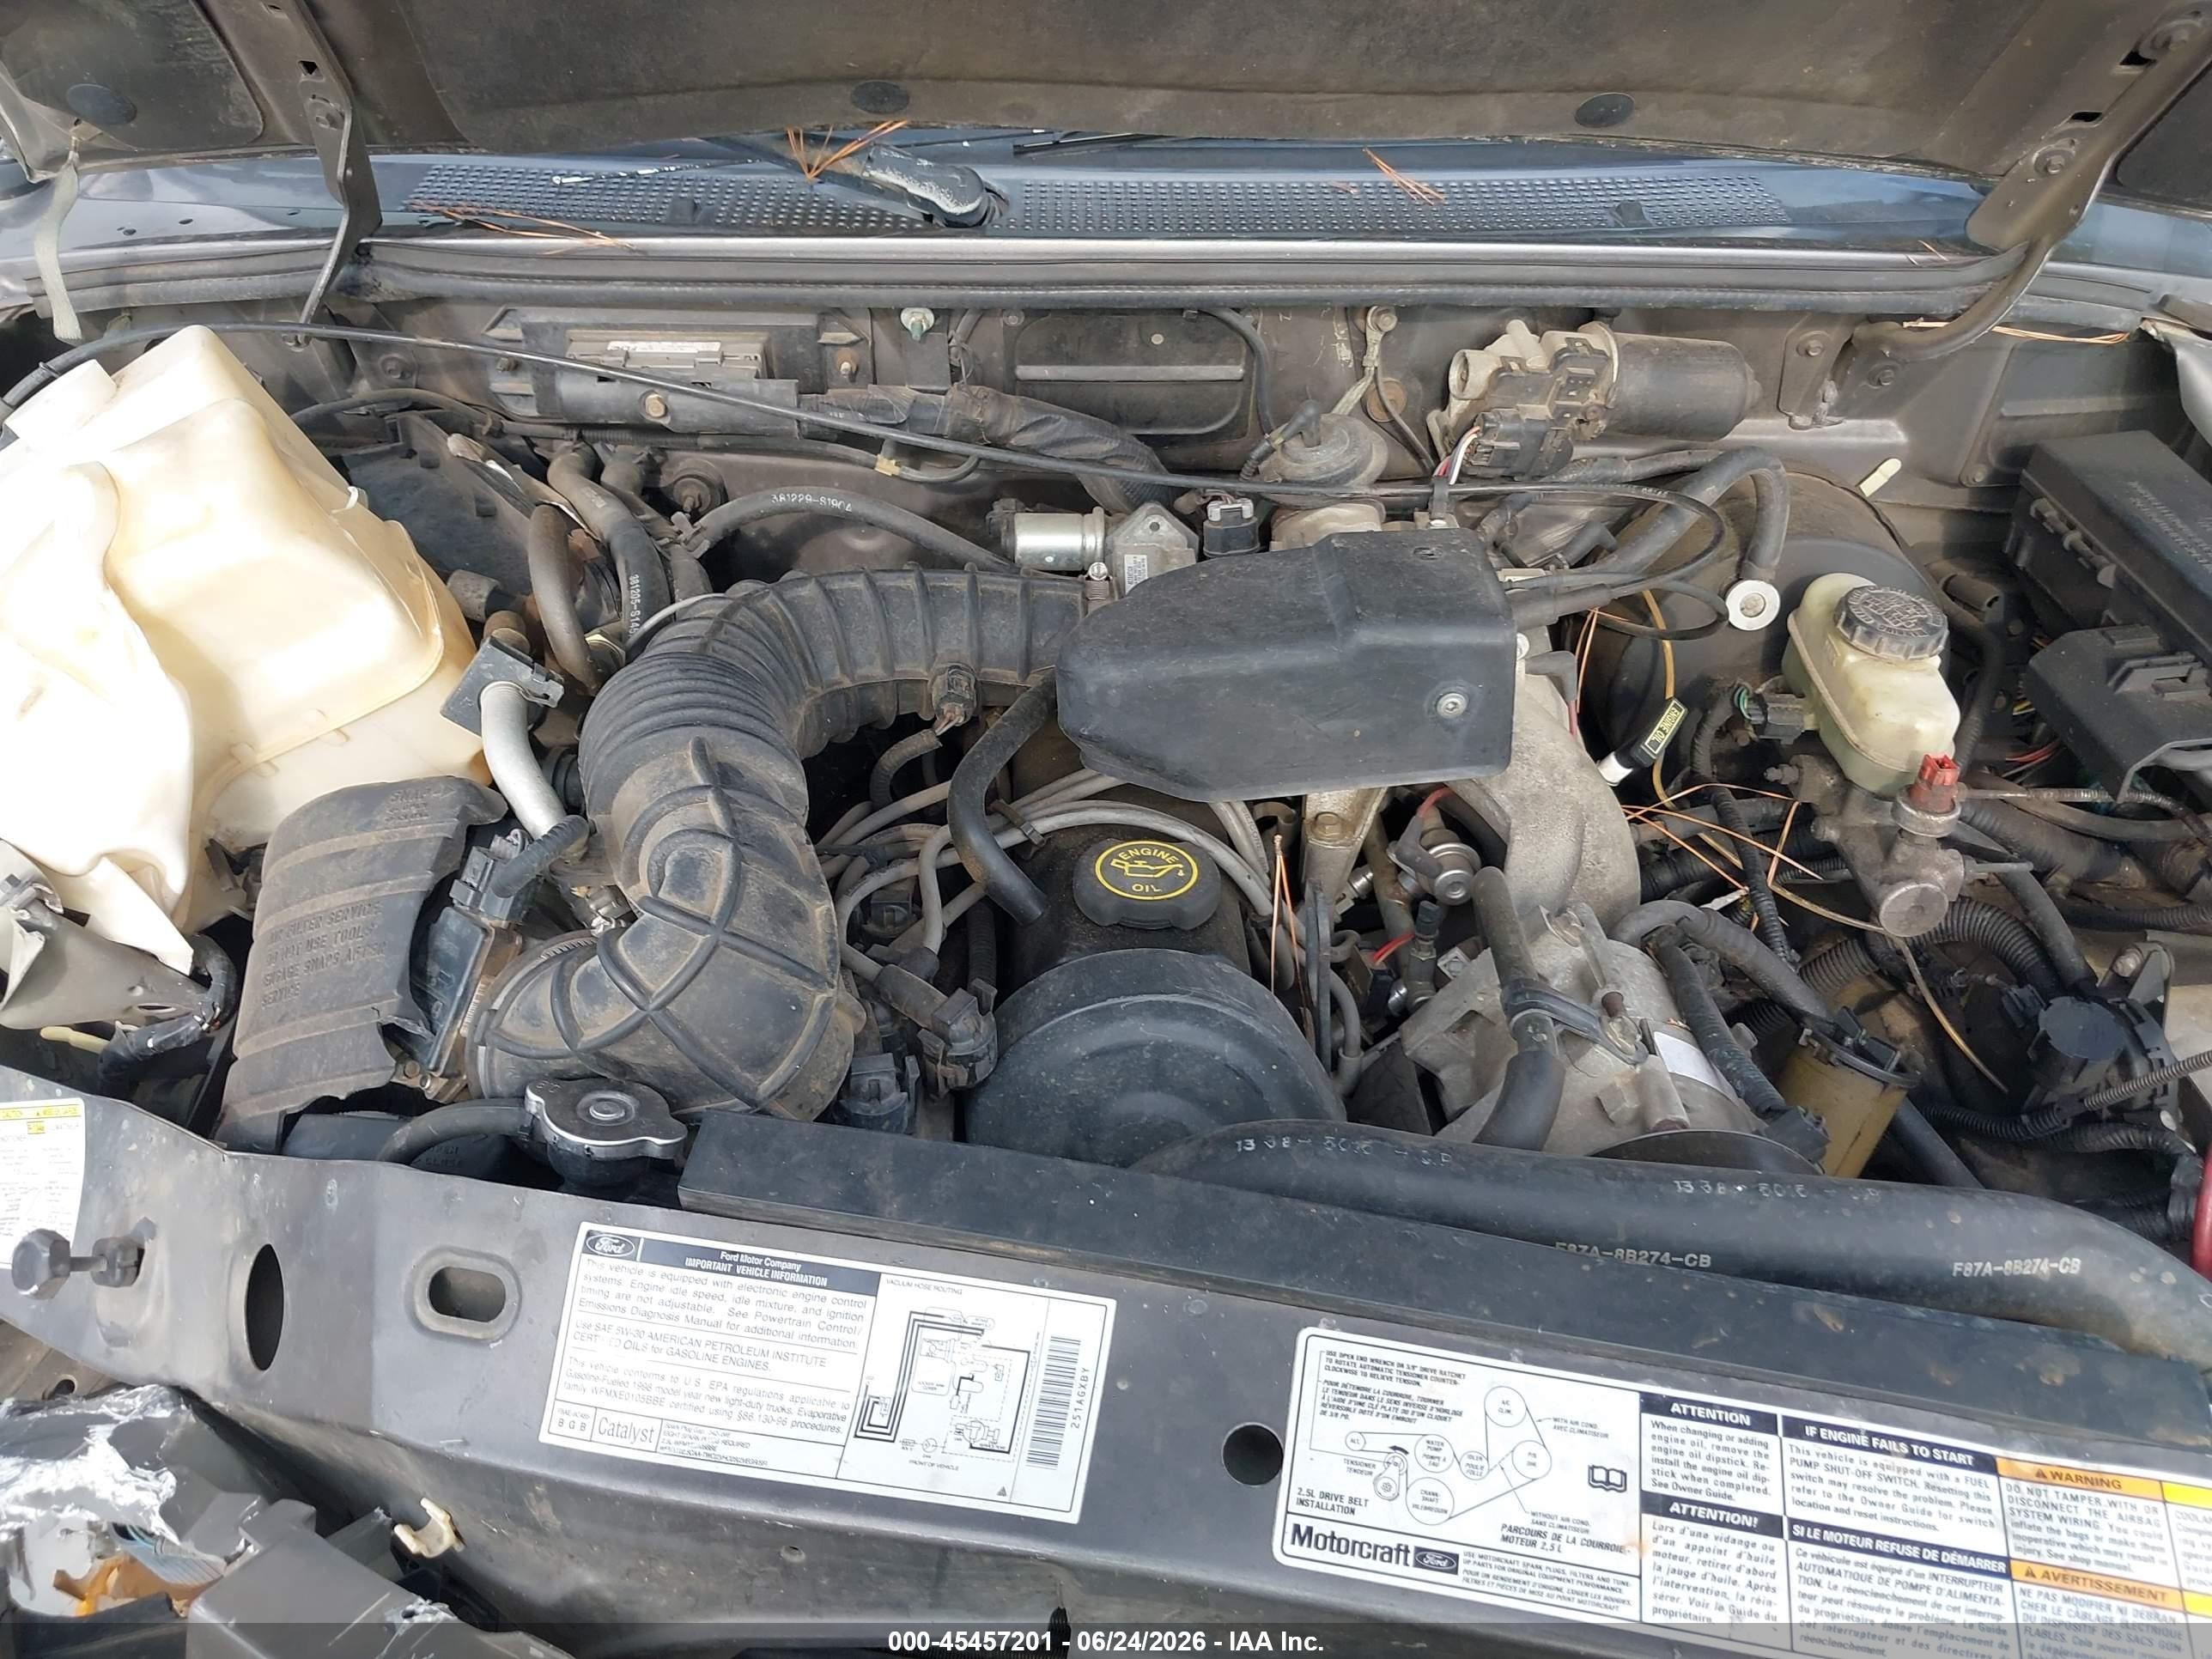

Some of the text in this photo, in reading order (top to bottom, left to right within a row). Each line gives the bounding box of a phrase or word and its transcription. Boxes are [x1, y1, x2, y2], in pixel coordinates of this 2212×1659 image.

[1650, 707, 1679, 743] ENGINE OIL
[1120, 847, 1180, 864] ENGINE
[1131, 884, 1163, 893] OIL
[593, 1235, 626, 1255] Ford
[684, 1257, 827, 1286] IMPORTANT VEHICLE INFORMATION
[720, 1251, 801, 1272] Ford Motor Company
[1952, 1256, 2082, 1277] F87A-8B274-CB
[586, 1259, 866, 1309] This vehicle is equipped with electronic engine control
[580, 1285, 861, 1336] timing are not adjustable. See Powertrain Control/
[629, 1279, 665, 1294] Engine
[670, 1285, 688, 1295] idle
[732, 1295, 750, 1304] idle
[801, 1305, 822, 1316] and
[826, 1309, 864, 1324] ignition
[578, 1298, 626, 1313] Emissions
[630, 1306, 680, 1323] Diagnosis
[684, 1315, 721, 1328] Manual
[726, 1322, 739, 1331] for
[744, 1324, 793, 1339] additional
[623, 1340, 647, 1352] OILS
[651, 1344, 663, 1354] for
[665, 1346, 719, 1363] GASOLINE
[647, 1331, 701, 1348] AMERICAN
[704, 1340, 769, 1358] PETROLEUM
[772, 1350, 826, 1367] INSTITUTE
[1070, 1367, 1090, 1428] 251AGXBY
[1670, 1402, 1750, 1425] ATTENTION
[597, 1417, 655, 1446] Catalyst
[1651, 1419, 1677, 1431] When
[1680, 1425, 1722, 1441] changing
[1738, 1437, 1768, 1449] adding
[1651, 1433, 1685, 1447] engine
[1711, 1443, 1748, 1455] remove
[1753, 1450, 1769, 1459] the
[1805, 1425, 1973, 1466] IF ENGINE FAILS TO START
[1651, 1444, 1684, 1457] engine
[1689, 1450, 1700, 1459] oil
[1753, 1461, 1769, 1471] Re-
[1651, 1455, 1770, 1485] install the engine oil dip-
[1789, 1444, 1810, 1455] This
[1815, 1449, 1854, 1463] vehicle
[1859, 1457, 1868, 1466] is
[1873, 1460, 1922, 1478] equipped
[1926, 1469, 1949, 1480] with
[1964, 1476, 1989, 1488] FUEL
[1651, 1468, 1771, 1497] stick when completed.
[1651, 1479, 1735, 1500] See Owner Guide.
[1790, 1456, 1819, 1470] PUMP
[1824, 1463, 1872, 1480] SHUT-OFF
[1973, 1492, 1990, 1501] this
[2050, 1470, 2122, 1490] WARNING
[1296, 1498, 1355, 1515] INSTALLATION
[1297, 1487, 1368, 1507] 2.5L DRIVE BELT
[2005, 1483, 2158, 1515] DO NOT TAMPER WITH OR
[2007, 1495, 2160, 1527] DISCONNECT THE AIRBAG
[1669, 1501, 1758, 1528] ATTENTION!
[2008, 1507, 2053, 1522] SYSTEM
[1290, 1523, 1411, 1565] Motorcraft
[1500, 1534, 1536, 1548] MOTEUR
[1540, 1541, 1553, 1552] 2,5
[1501, 1523, 1547, 1539] PARCOURS
[1552, 1533, 1562, 1541] DE
[1566, 1535, 1576, 1545] LA
[1792, 1524, 2006, 1573] SI LE MOTEUR REFUSE DE DÉMARRER
[1423, 1553, 1448, 1566] Ford
[2039, 1570, 2167, 1601] AVERTISSEMENT
